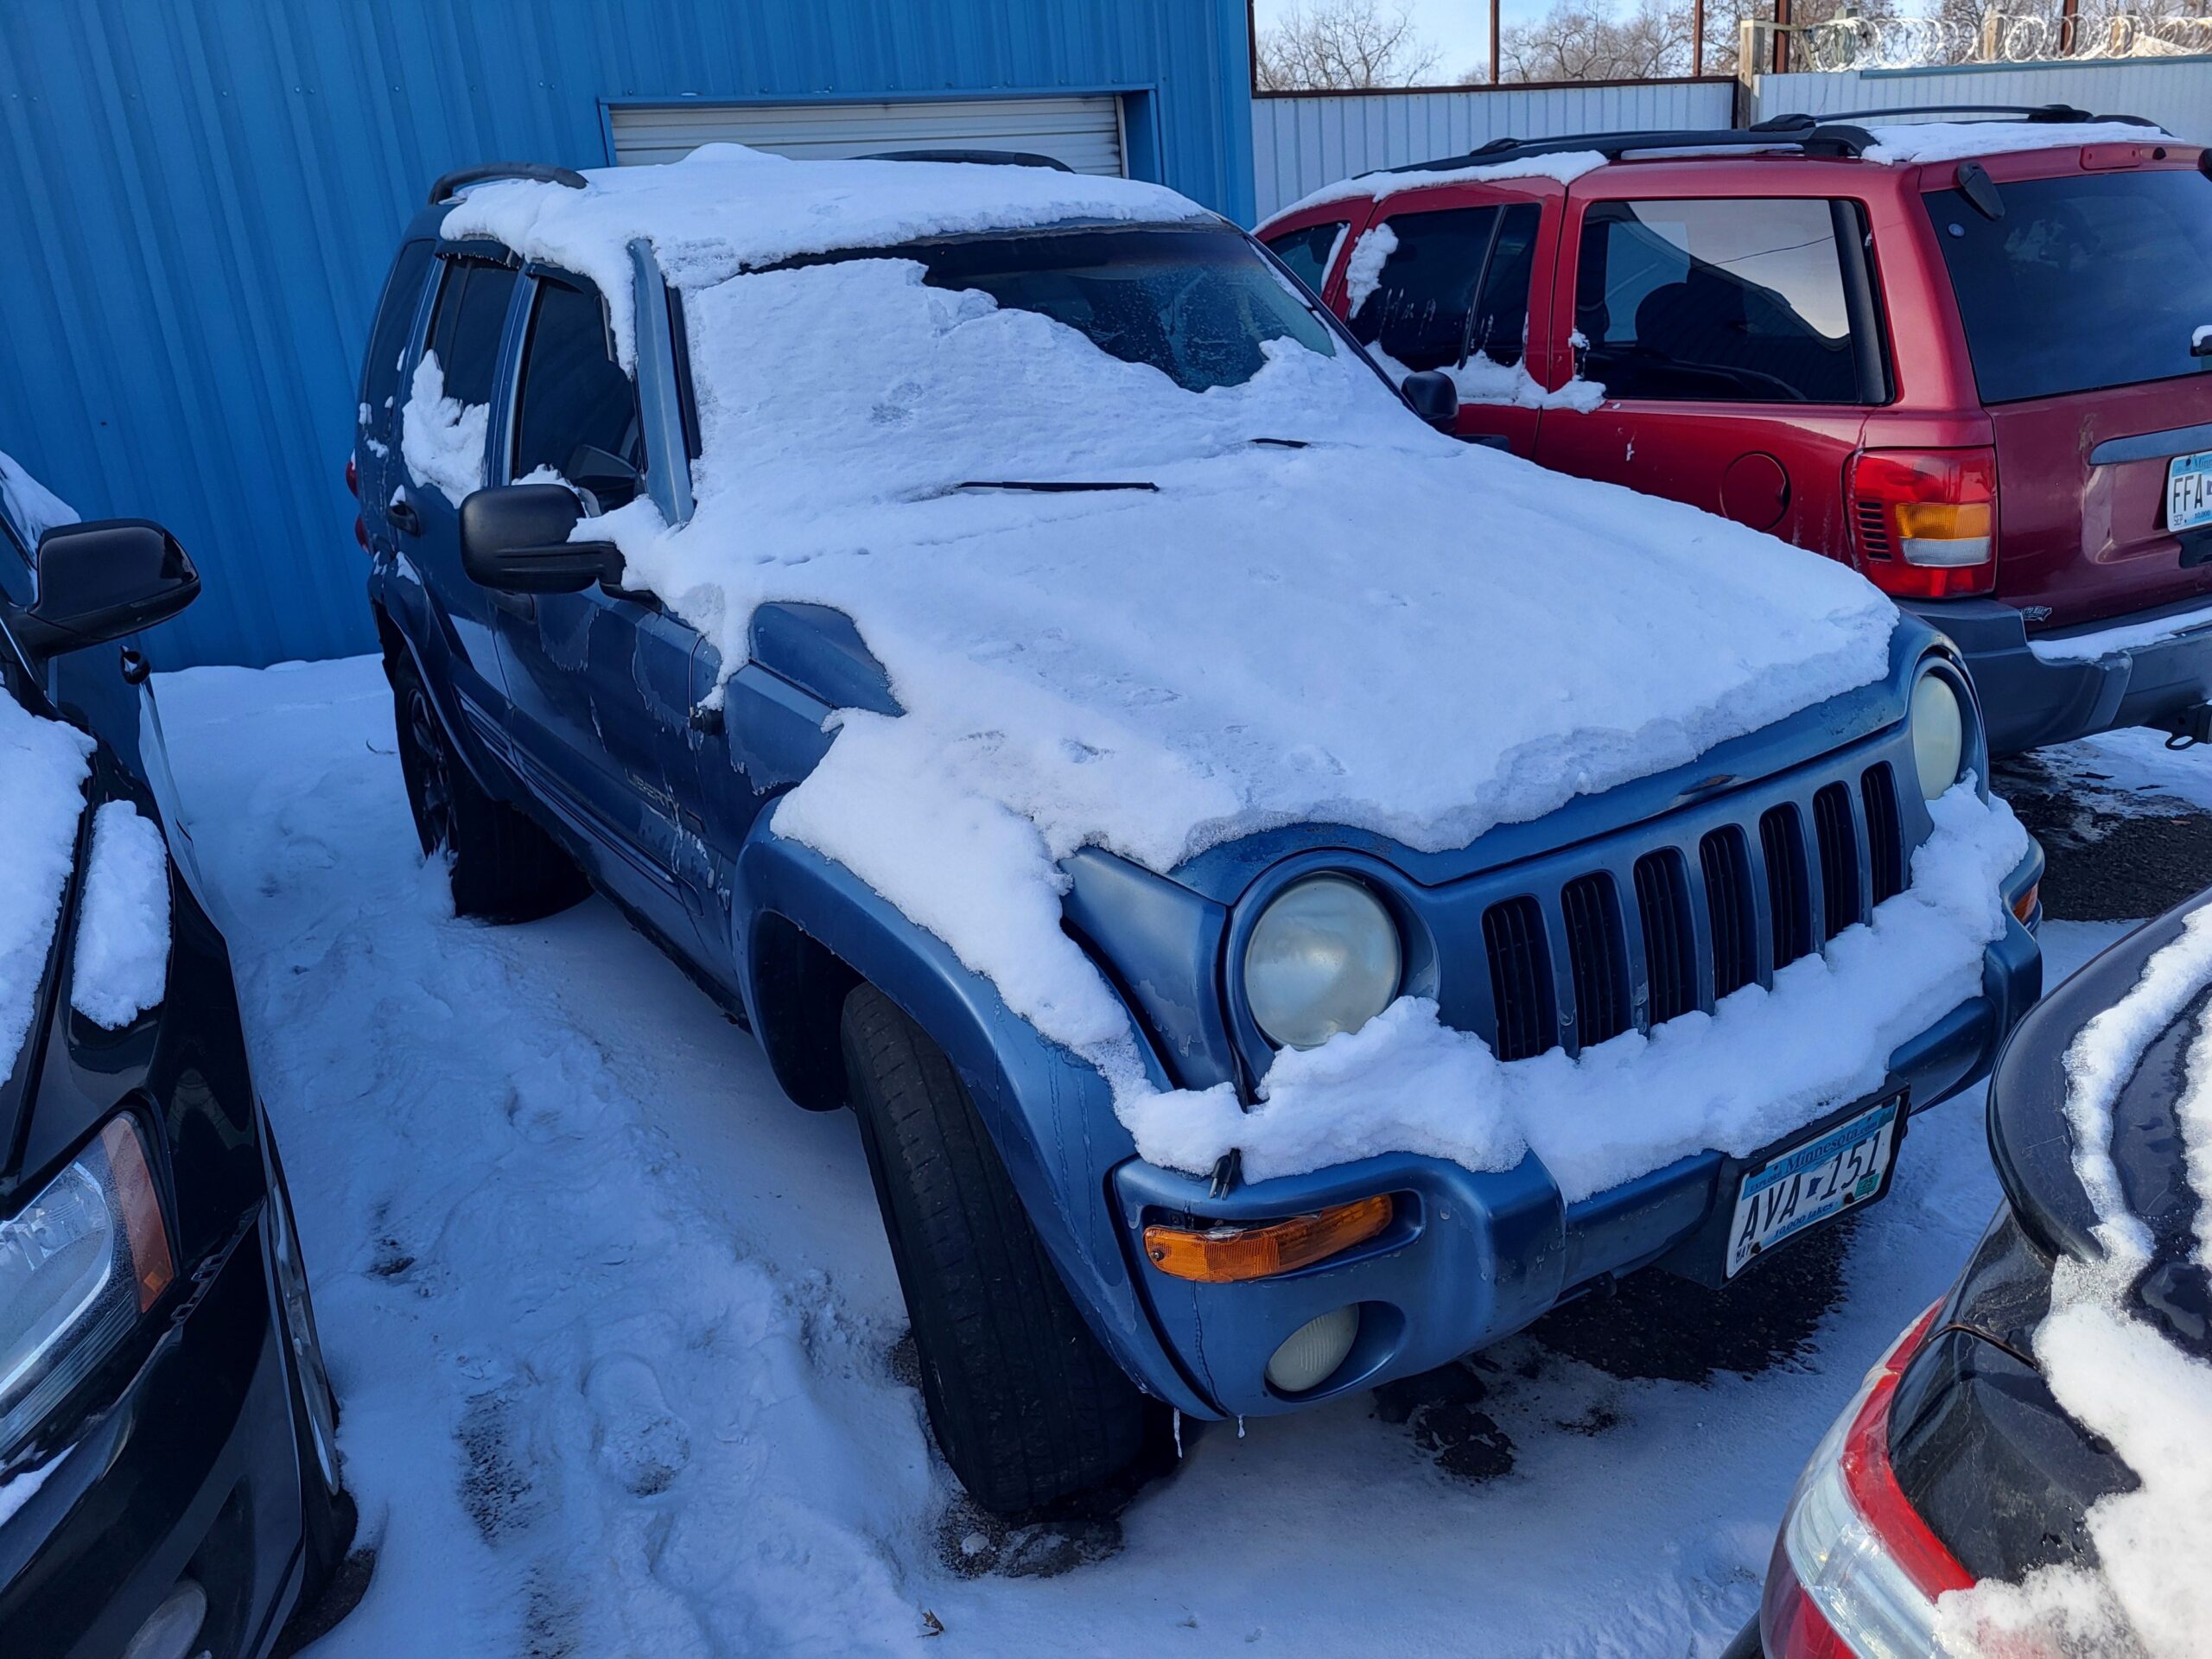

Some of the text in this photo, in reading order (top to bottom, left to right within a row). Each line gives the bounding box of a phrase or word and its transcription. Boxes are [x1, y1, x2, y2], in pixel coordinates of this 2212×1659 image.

[2173, 474, 2202, 513] FFA
[2173, 514, 2183, 526] SEP
[1738, 1129, 1881, 1248] AVA 151
[1808, 1201, 1834, 1220] lakes
[1735, 1242, 1752, 1264] MAY
